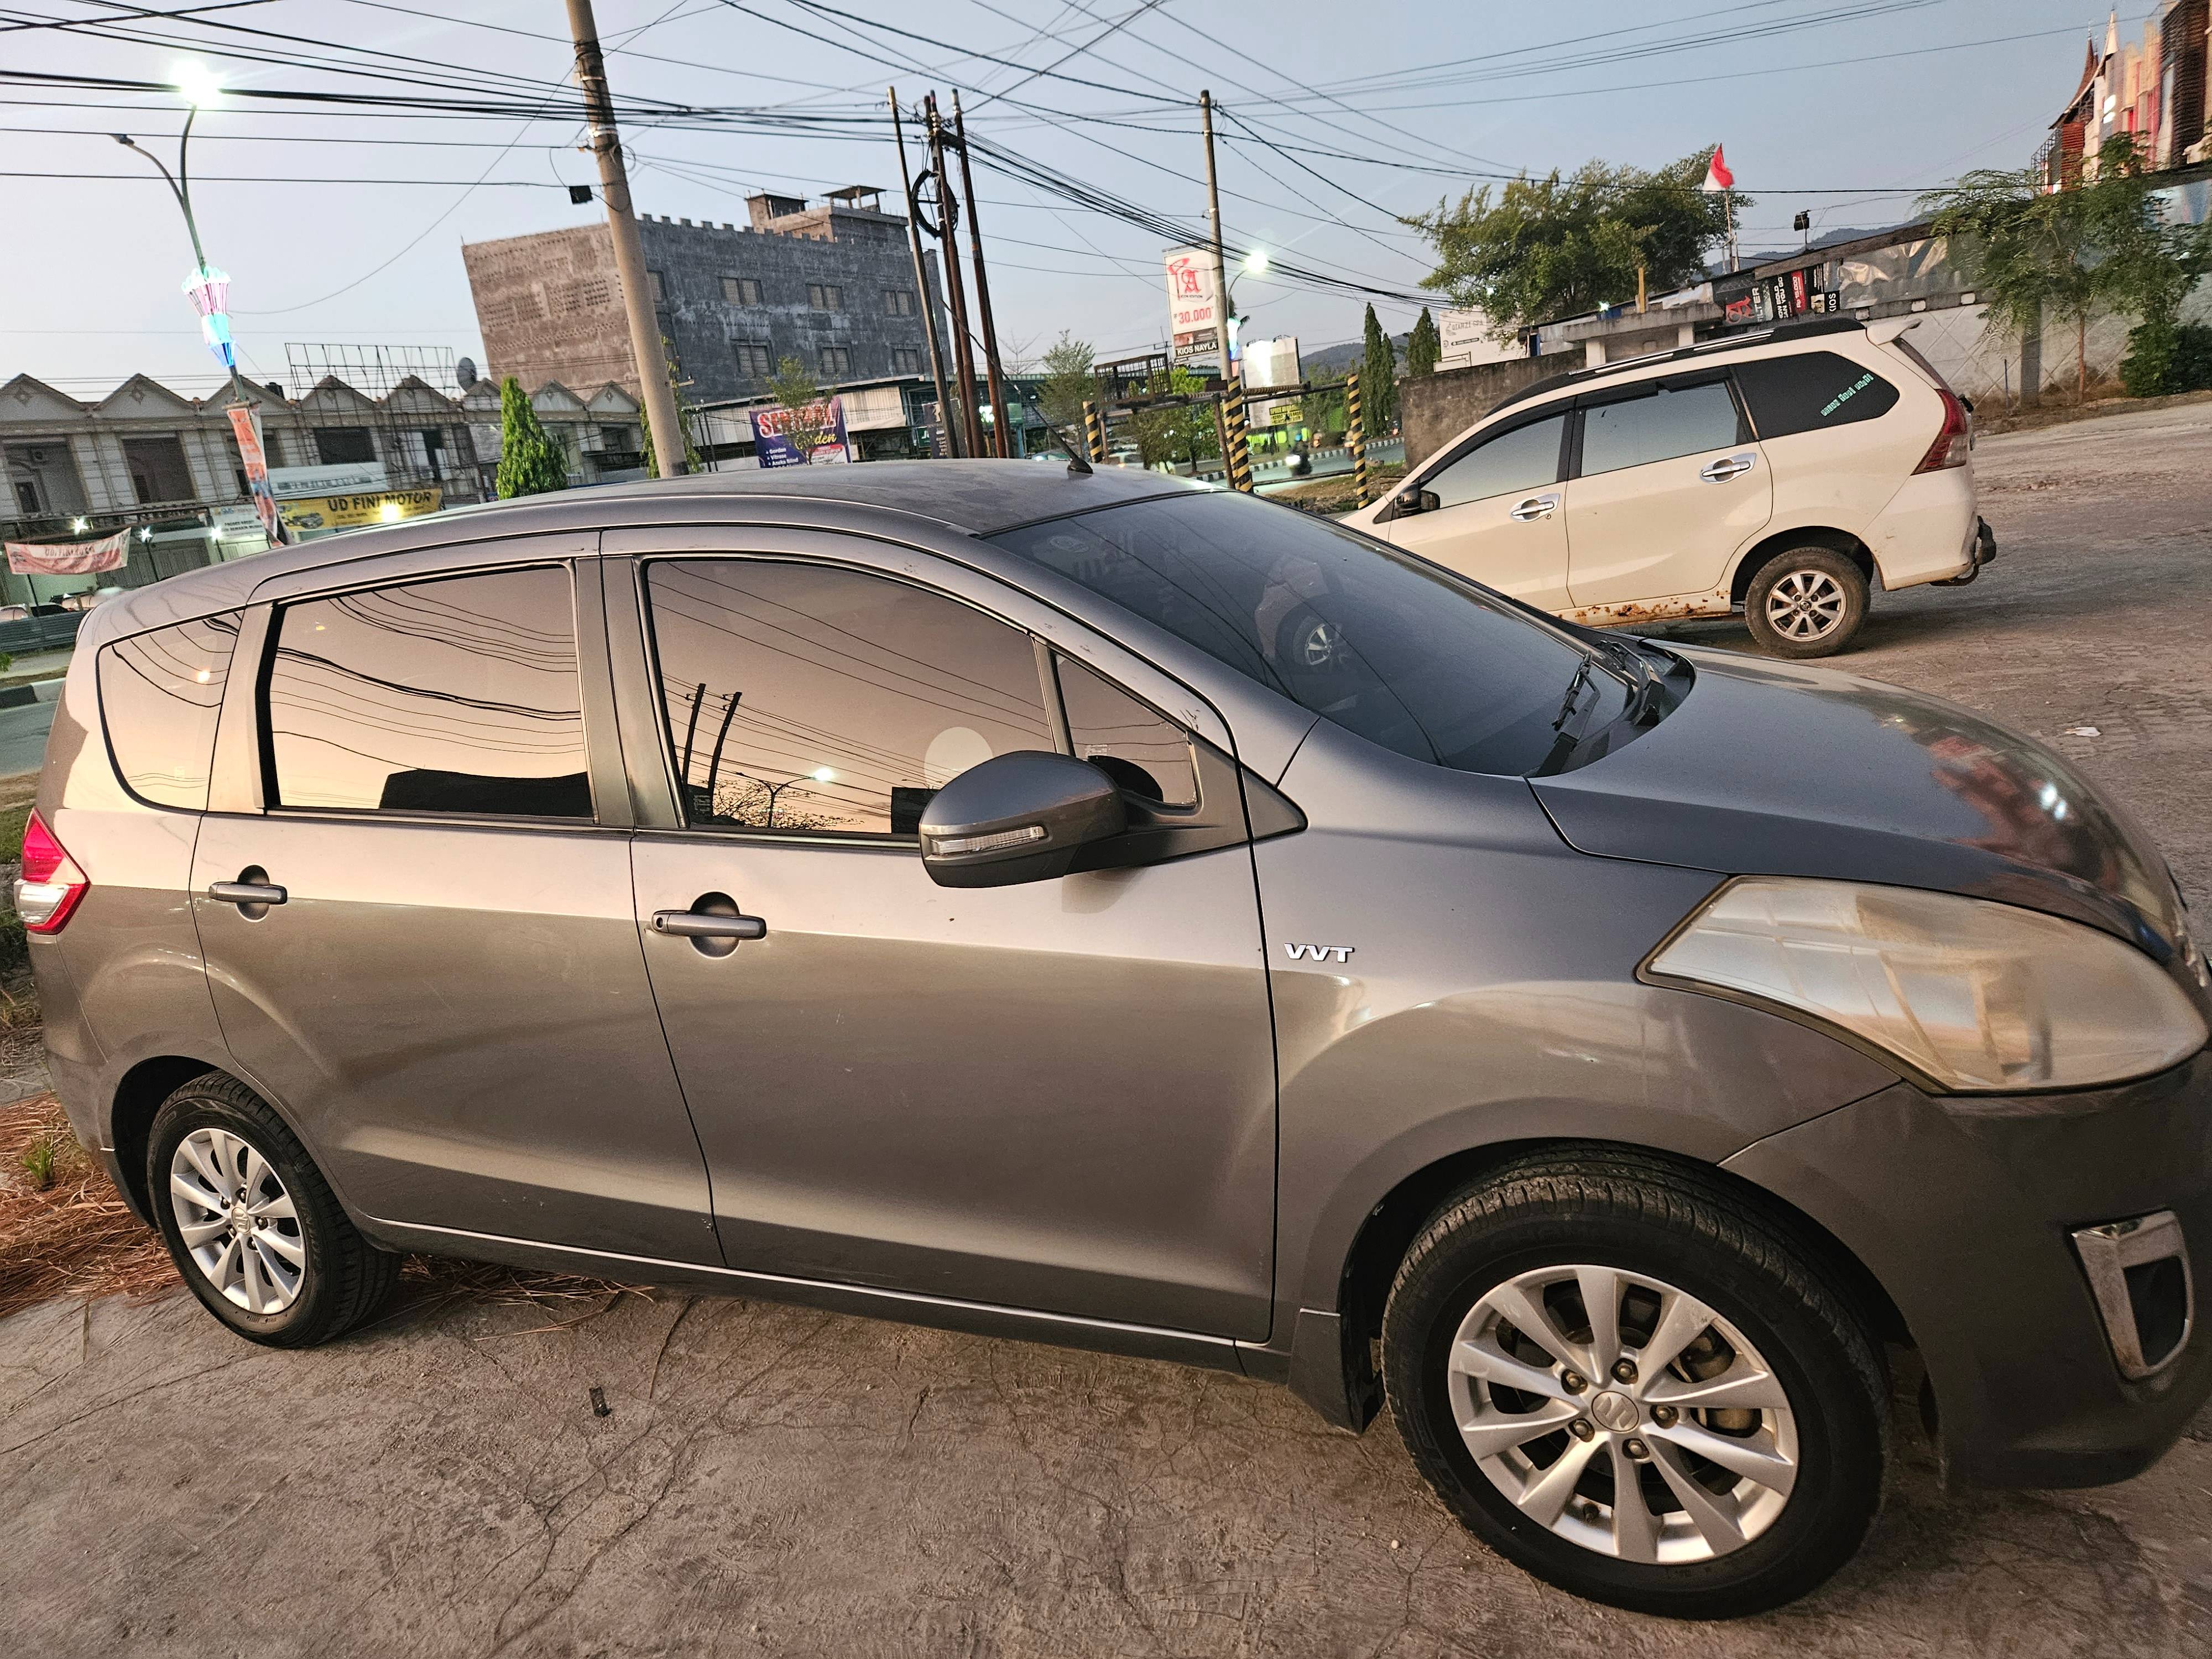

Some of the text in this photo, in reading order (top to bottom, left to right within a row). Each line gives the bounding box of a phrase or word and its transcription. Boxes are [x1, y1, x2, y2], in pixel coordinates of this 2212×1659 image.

[1778, 276, 1784, 288] GO
[1178, 307, 1212, 324] 30.000
[1177, 342, 1217, 356] KIOS NAYLA
[327, 491, 432, 512] UD FINI MOTOR
[1284, 943, 1355, 963] VVT
